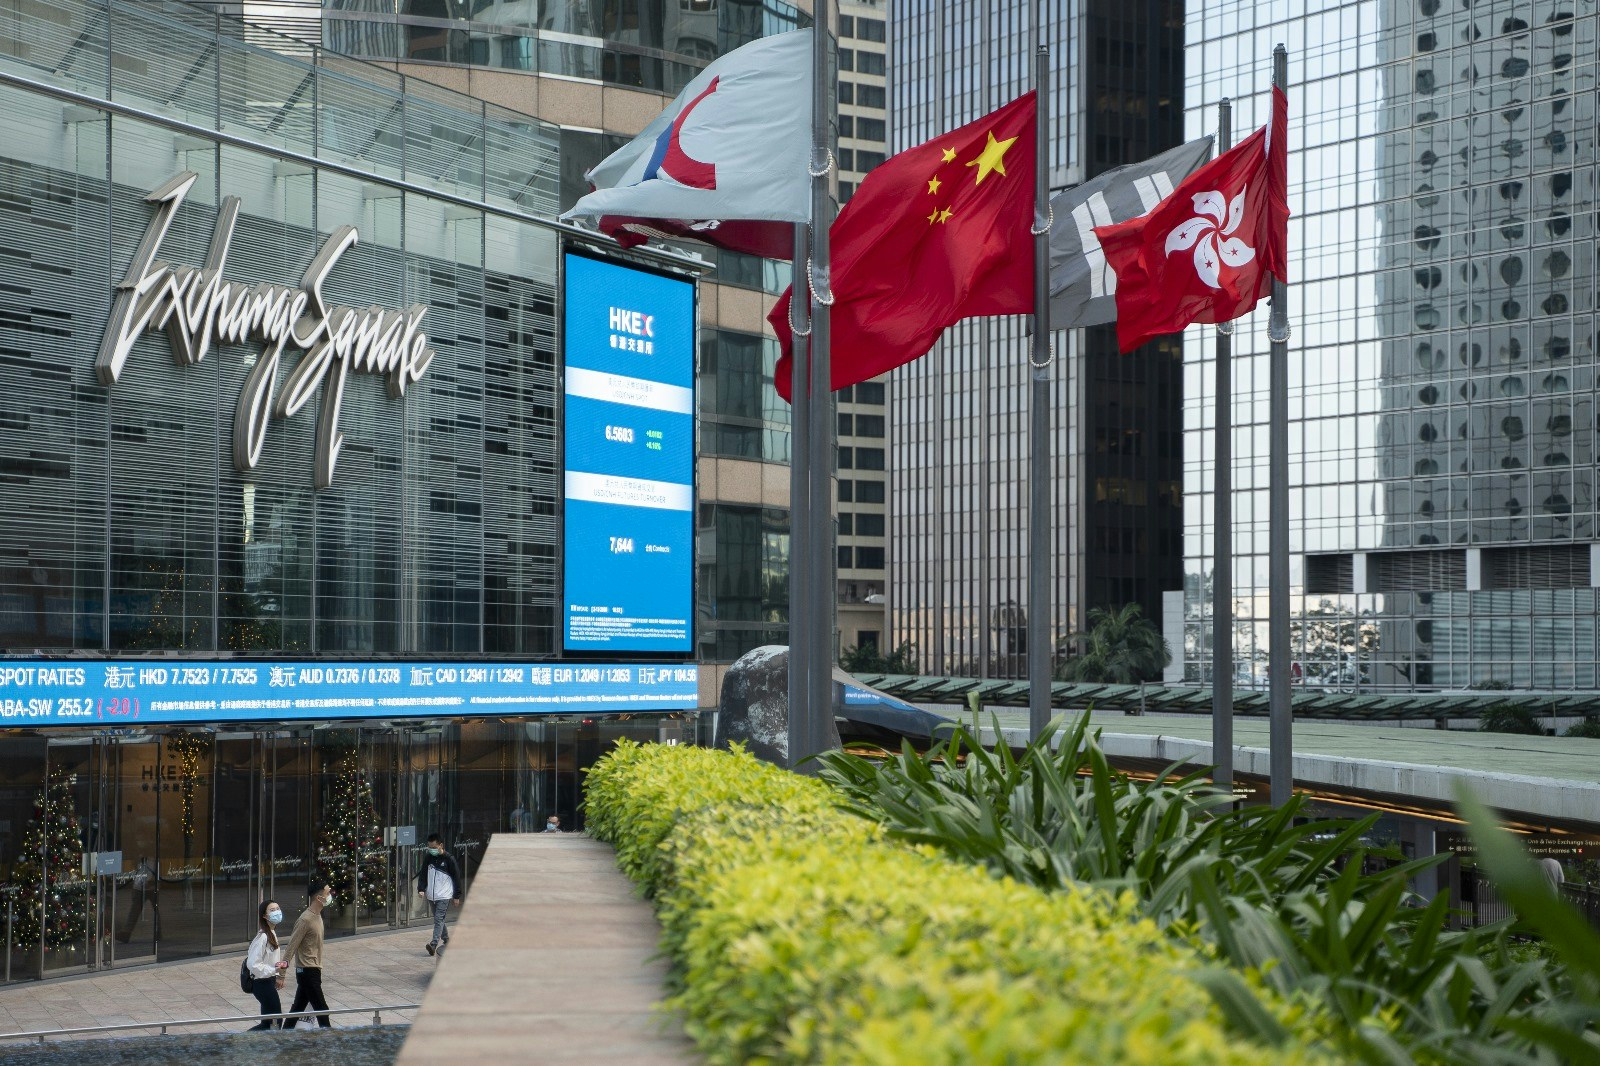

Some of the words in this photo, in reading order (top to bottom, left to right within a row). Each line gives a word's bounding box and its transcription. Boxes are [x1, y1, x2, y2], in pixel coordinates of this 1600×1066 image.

[94, 170, 322, 470] Exchange
[276, 224, 434, 488] Square
[609, 306, 654, 337] HKEX
[605, 425, 633, 443] 6.5603
[609, 537, 634, 554] 7,644
[0, 668, 36, 686] SPOT
[38, 668, 86, 686] RATES
[104, 666, 136, 688] 港元
[140, 668, 168, 684] HKD
[171, 668, 210, 684] 7.7523
[221, 668, 258, 684] 7.7525
[269, 666, 297, 687] 澳元
[299, 668, 323, 684] AUD
[326, 668, 359, 683] 0.7376
[369, 668, 401, 683] 0.7378
[410, 667, 433, 686] 加元
[436, 668, 457, 683] CAD
[460, 668, 487, 683] 1.2941
[496, 668, 524, 683] 1.2942
[554, 668, 572, 682] EUR
[657, 668, 672, 682] JPY
[57, 698, 93, 716] 255.2
